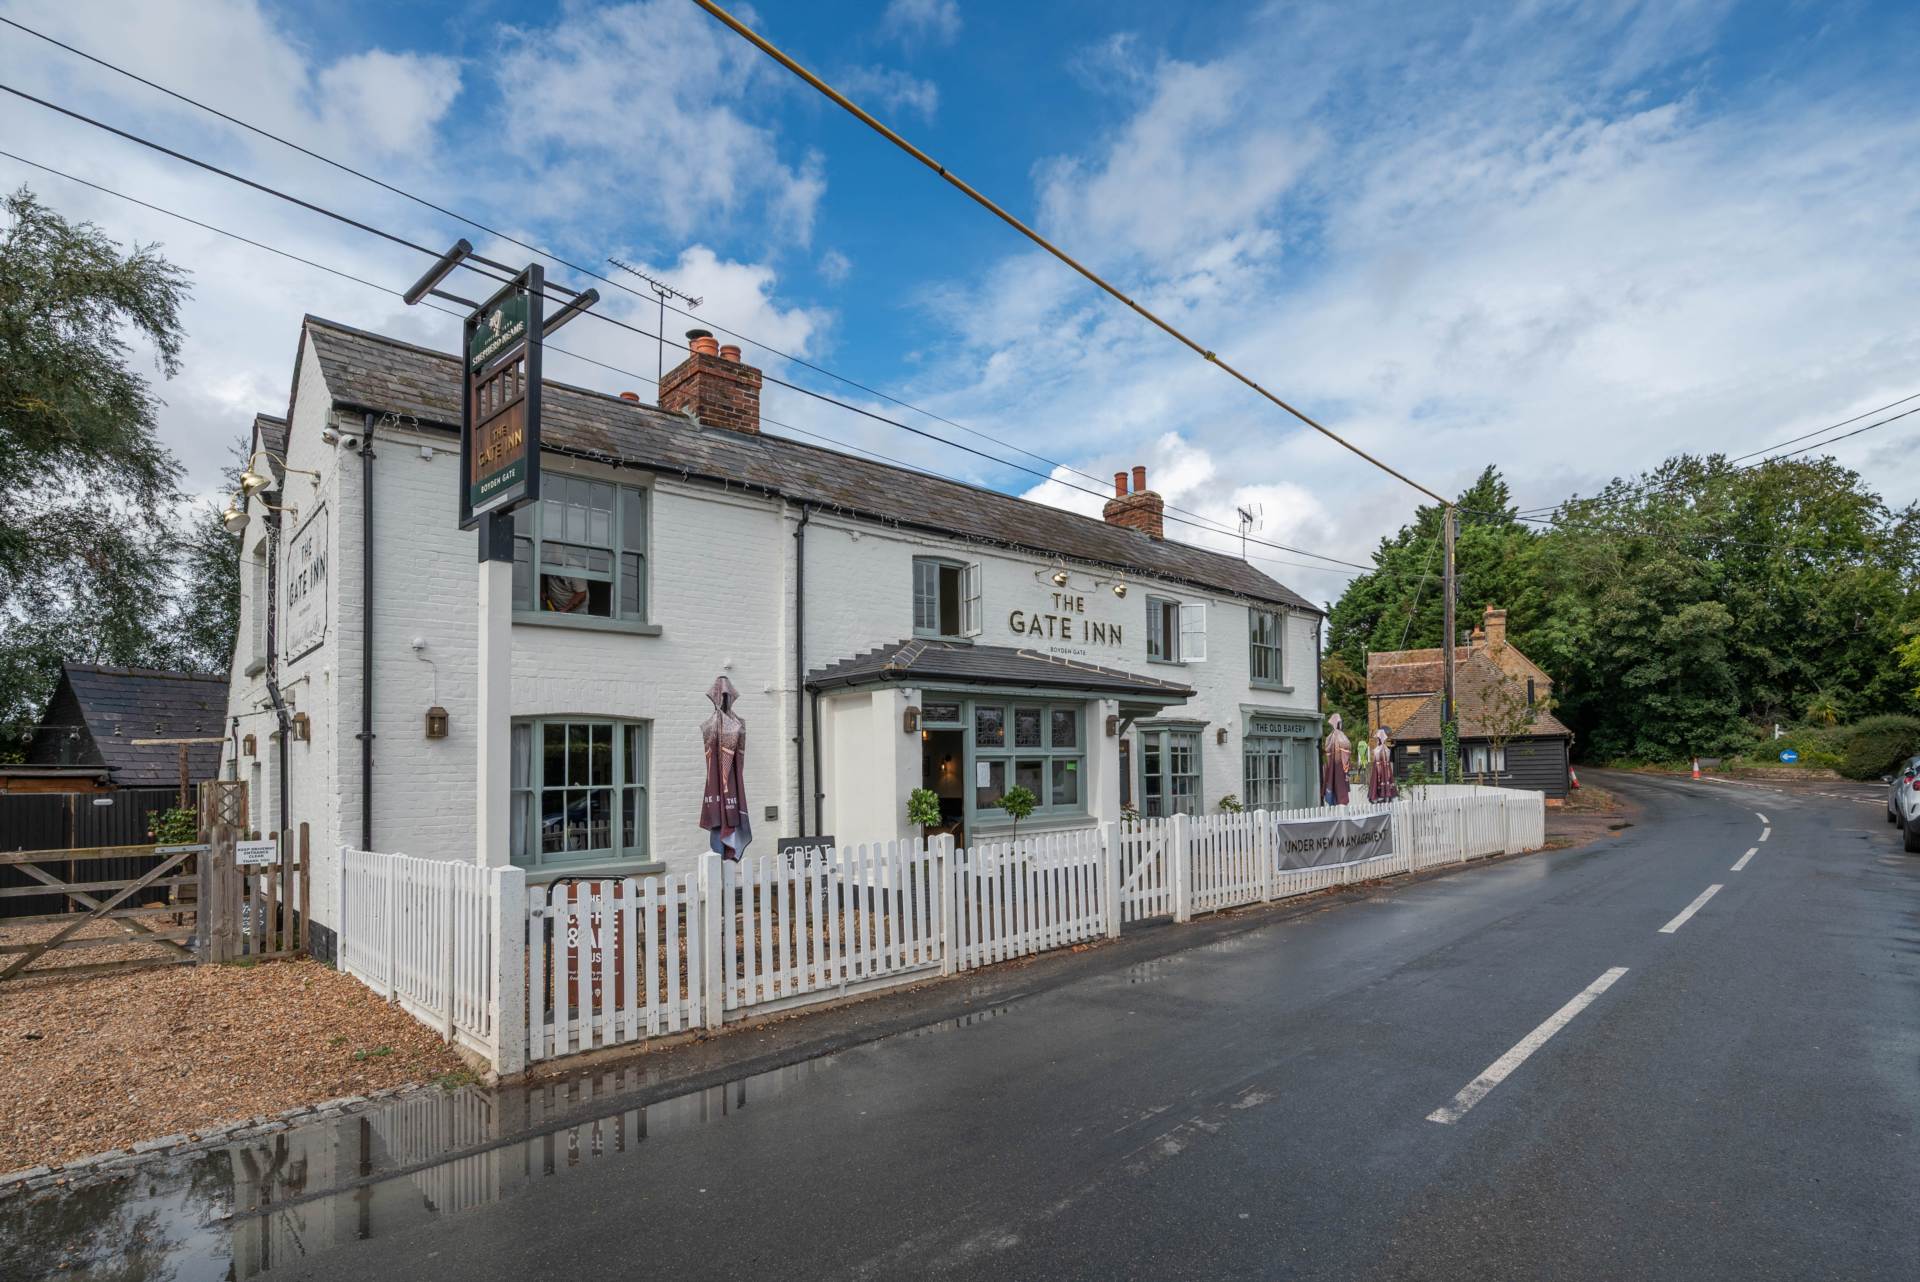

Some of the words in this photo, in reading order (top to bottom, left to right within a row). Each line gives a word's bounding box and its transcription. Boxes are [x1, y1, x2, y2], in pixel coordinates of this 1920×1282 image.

[472, 338, 502, 366] SHEPHERD
[502, 320, 524, 343] NEAME
[492, 425, 507, 440] THE
[479, 443, 502, 467] GATE
[505, 429, 522, 452] INN
[481, 477, 501, 493] BOYDEN
[502, 468, 516, 482] GATE
[301, 537, 312, 564] THE
[289, 569, 307, 607] GATE
[310, 550, 326, 588] INN
[1052, 592, 1084, 613] THE
[1009, 610, 1072, 640] GATE
[1084, 620, 1122, 644] INN
[1050, 646, 1072, 654] BOYDEN
[1073, 648, 1086, 656] GATE
[1256, 723, 1268, 732] THE
[1269, 723, 1281, 732] OLD
[1283, 723, 1306, 733] BAKERY
[1284, 839, 1314, 853] UNDER
[1316, 837, 1333, 850] NEW
[1336, 829, 1387, 848] MANAGEMENT
